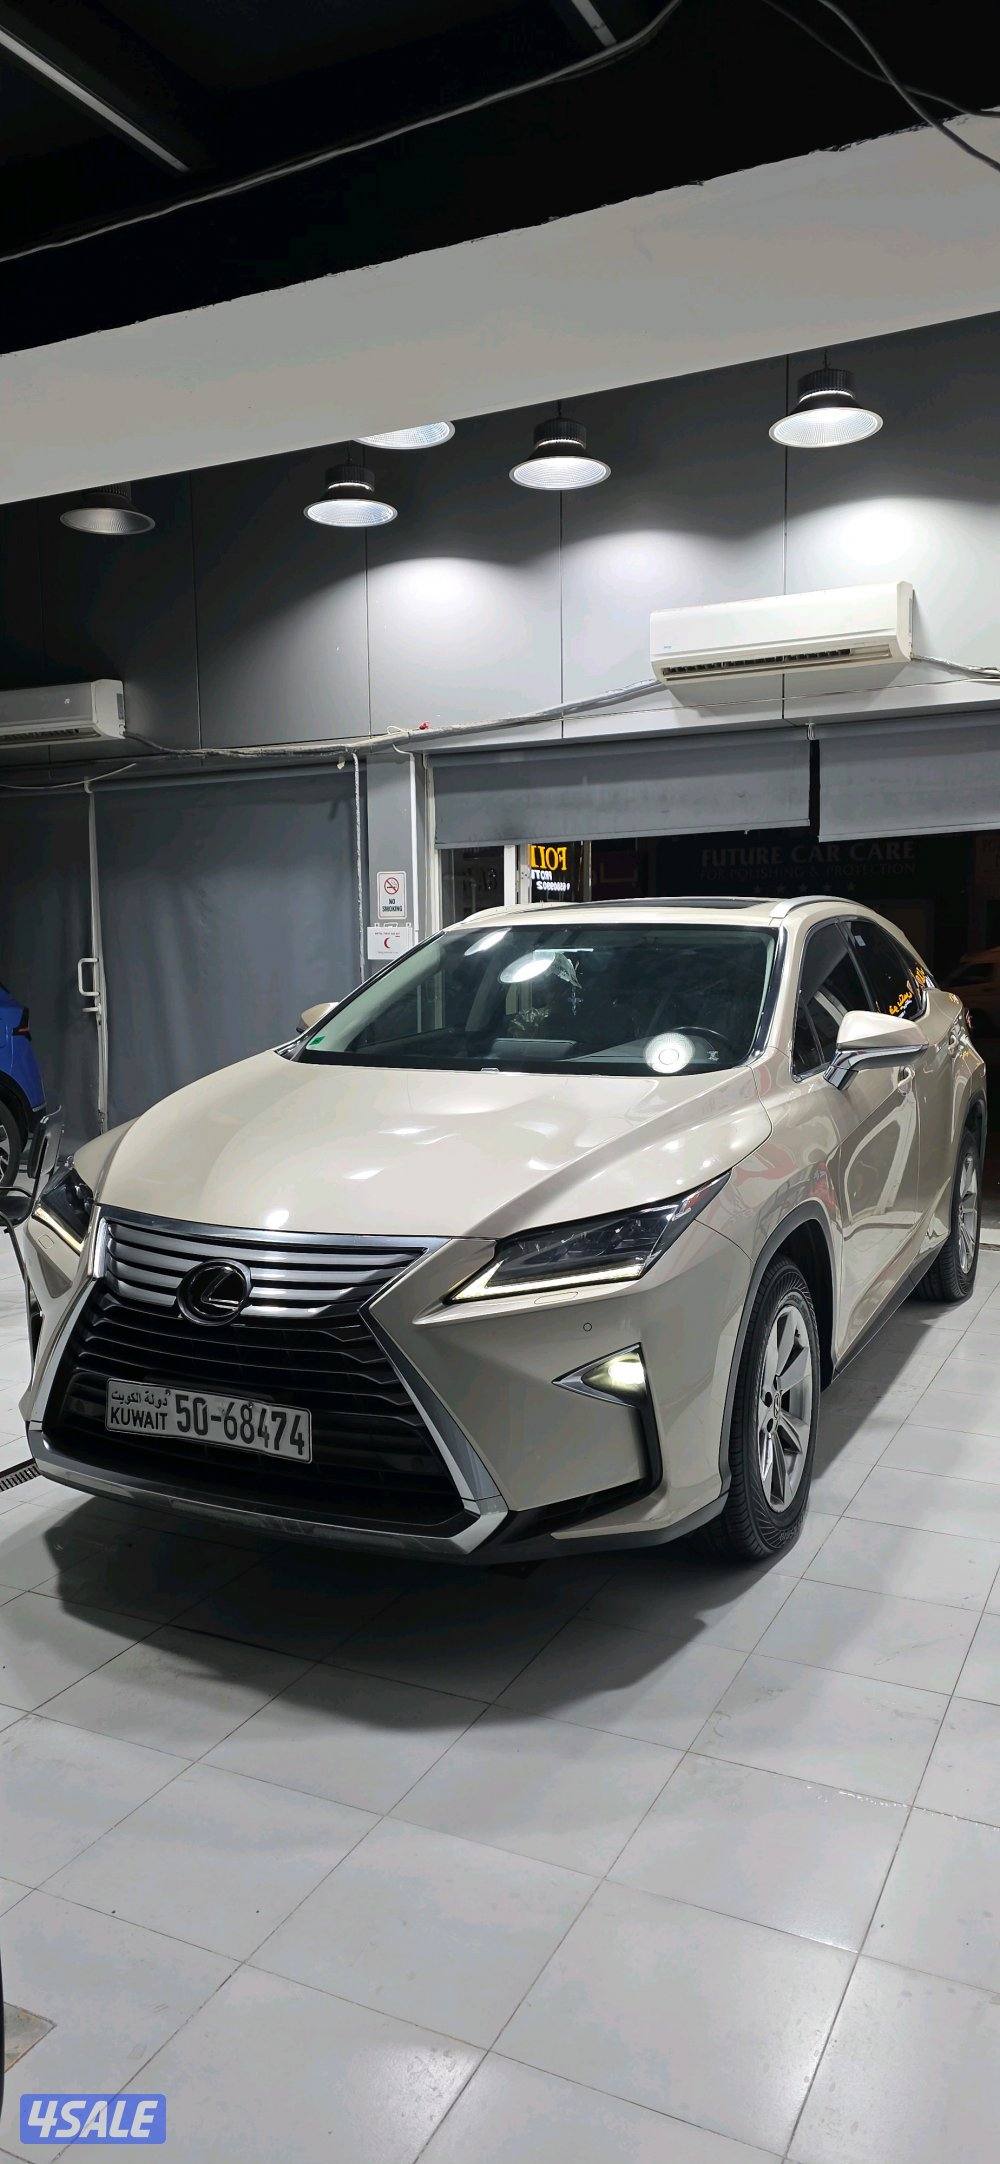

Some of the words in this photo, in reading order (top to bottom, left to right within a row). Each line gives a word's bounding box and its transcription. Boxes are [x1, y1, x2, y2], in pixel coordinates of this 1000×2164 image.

[701, 846, 784, 867] FUTURE
[790, 844, 841, 865] CAR
[848, 840, 916, 862] CARE
[111, 1391, 142, 1406] الكويت
[145, 1391, 168, 1409] دولة
[110, 1407, 168, 1430] KUWAIT
[174, 1394, 306, 1456] 50-68474
